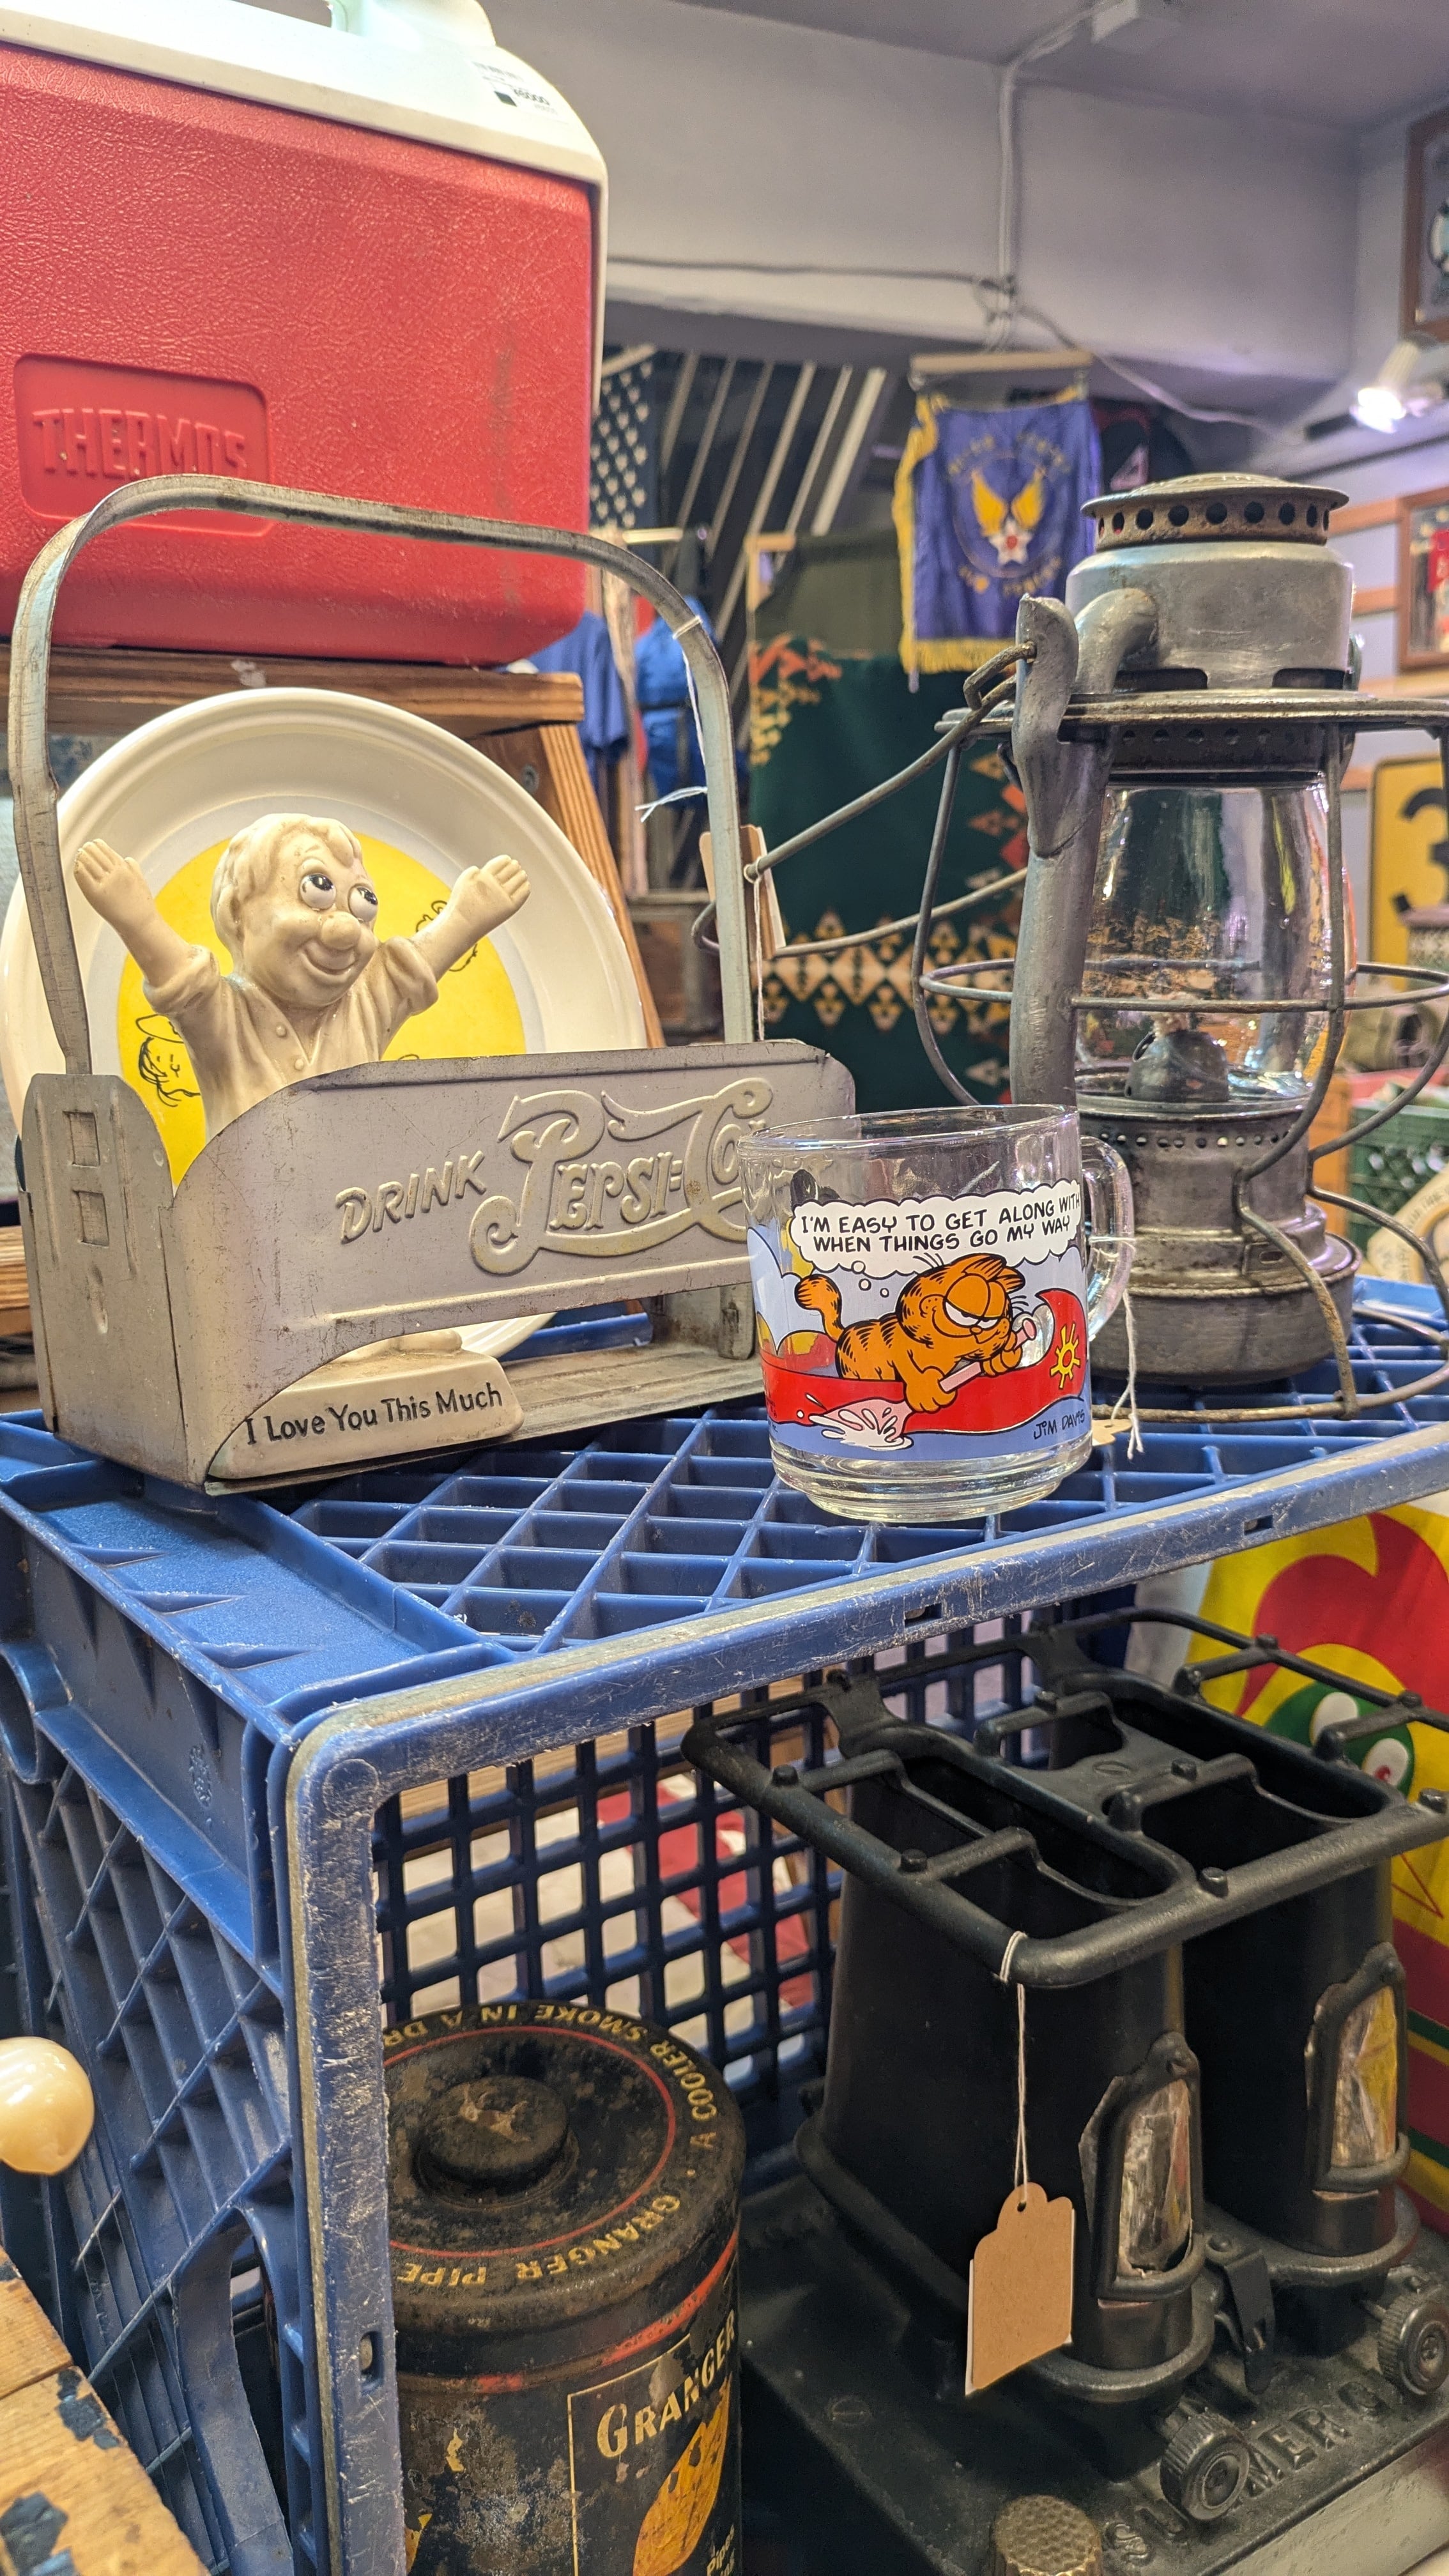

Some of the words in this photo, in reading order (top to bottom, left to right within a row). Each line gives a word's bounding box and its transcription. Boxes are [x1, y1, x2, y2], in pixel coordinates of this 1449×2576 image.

[31, 408, 247, 479] THERMOS
[335, 1150, 487, 1245] DRINK
[801, 1215, 831, 1233] I'M
[839, 1216, 896, 1234] EASY
[906, 1215, 935, 1232] TO
[946, 1209, 987, 1230] GET
[999, 1197, 1054, 1225] ALONG
[1059, 1193, 1080, 1212] WITH
[813, 1236, 871, 1253] WHEN
[879, 1232, 960, 1252] THINGS
[969, 1229, 998, 1248] GO
[1007, 1223, 1035, 1243] MY
[1041, 1215, 1071, 1236] WAY
[246, 1417, 257, 1445] I
[263, 1414, 326, 1442] Love
[327, 1404, 378, 1432] You
[381, 1395, 431, 1423] This
[435, 1381, 503, 1415] Much
[441, 2010, 464, 2028] A
[480, 2004, 518, 2023] IN
[534, 2004, 648, 2042] SMOKE
[649, 2039, 717, 2120] COOLER
[515, 2194, 682, 2281] GRANGER
[397, 2262, 487, 2287] PIPE
[597, 2308, 735, 2458] GRANGER
